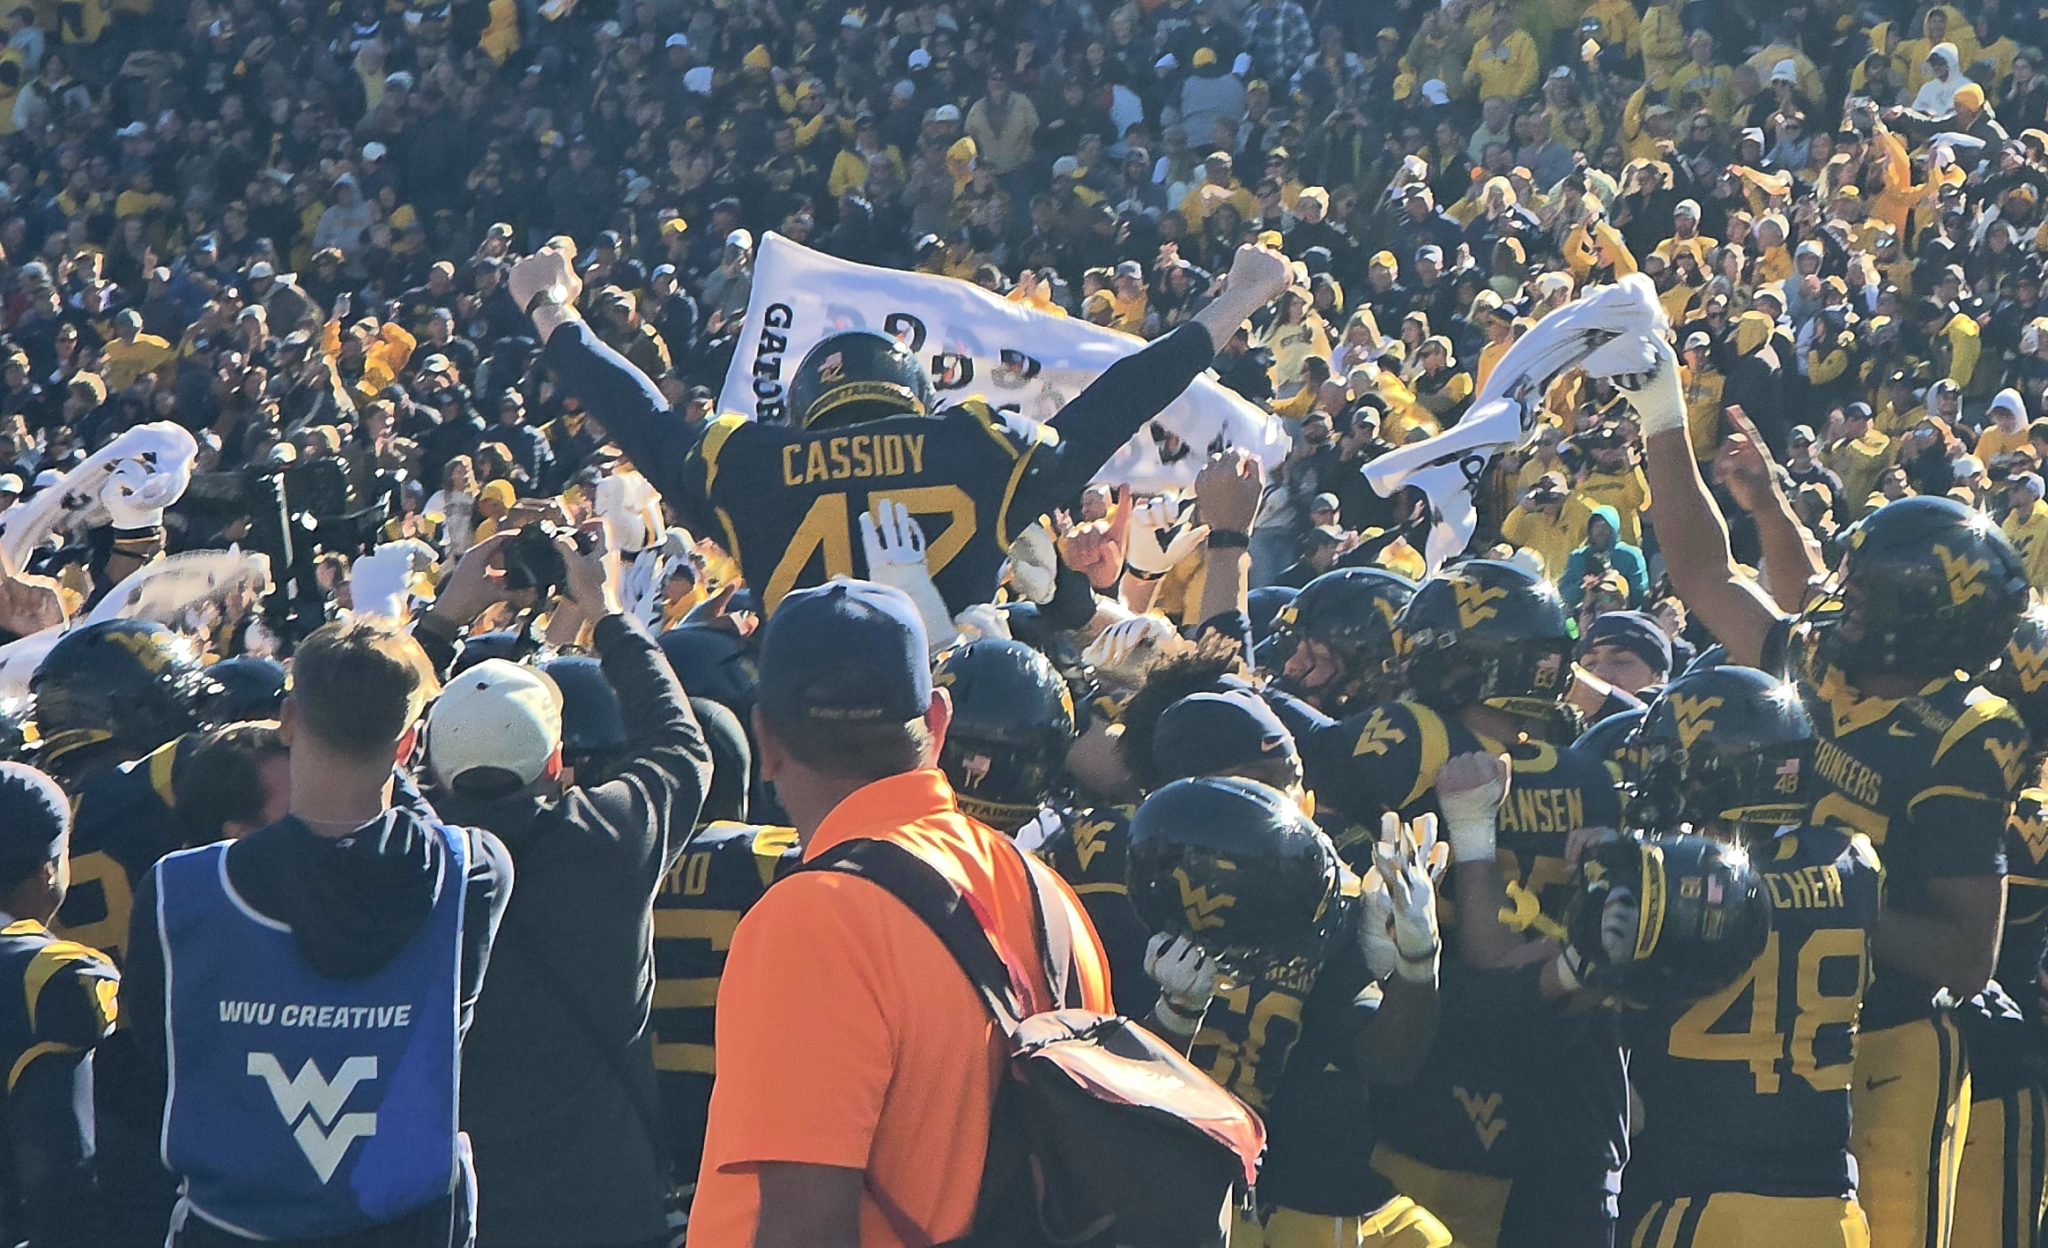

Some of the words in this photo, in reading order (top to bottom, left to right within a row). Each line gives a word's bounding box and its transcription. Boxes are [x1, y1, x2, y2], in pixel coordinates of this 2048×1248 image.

[782, 433, 926, 487] CASSIDY
[219, 1000, 276, 1026] WVU
[280, 1004, 412, 1030] CREATIVE
[1667, 928, 1867, 1095] 48
